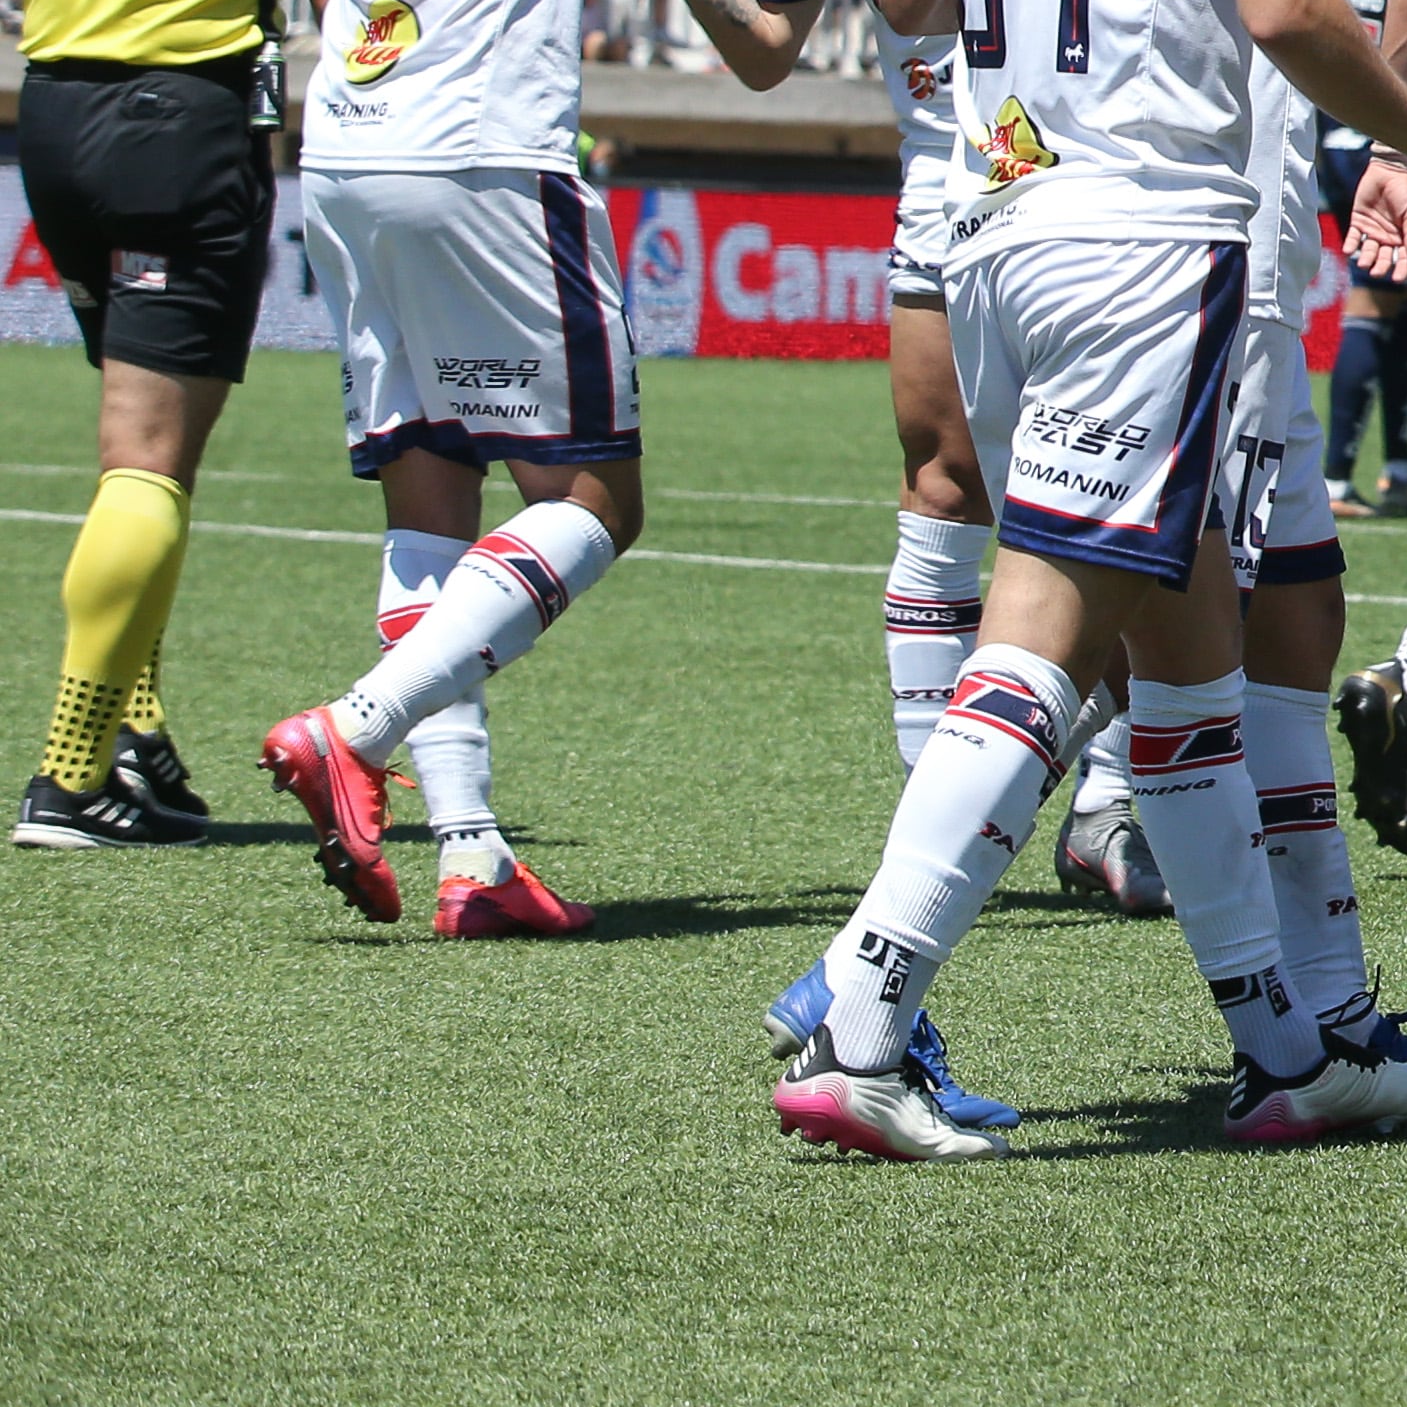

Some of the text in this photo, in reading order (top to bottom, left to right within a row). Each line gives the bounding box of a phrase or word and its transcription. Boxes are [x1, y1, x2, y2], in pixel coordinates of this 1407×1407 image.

[434, 358, 541, 372] WORLD
[438, 371, 541, 389] FAST
[1025, 421, 1146, 461] FAST
[1036, 402, 1152, 442] WORLD
[1014, 456, 1131, 503] ROMANINI
